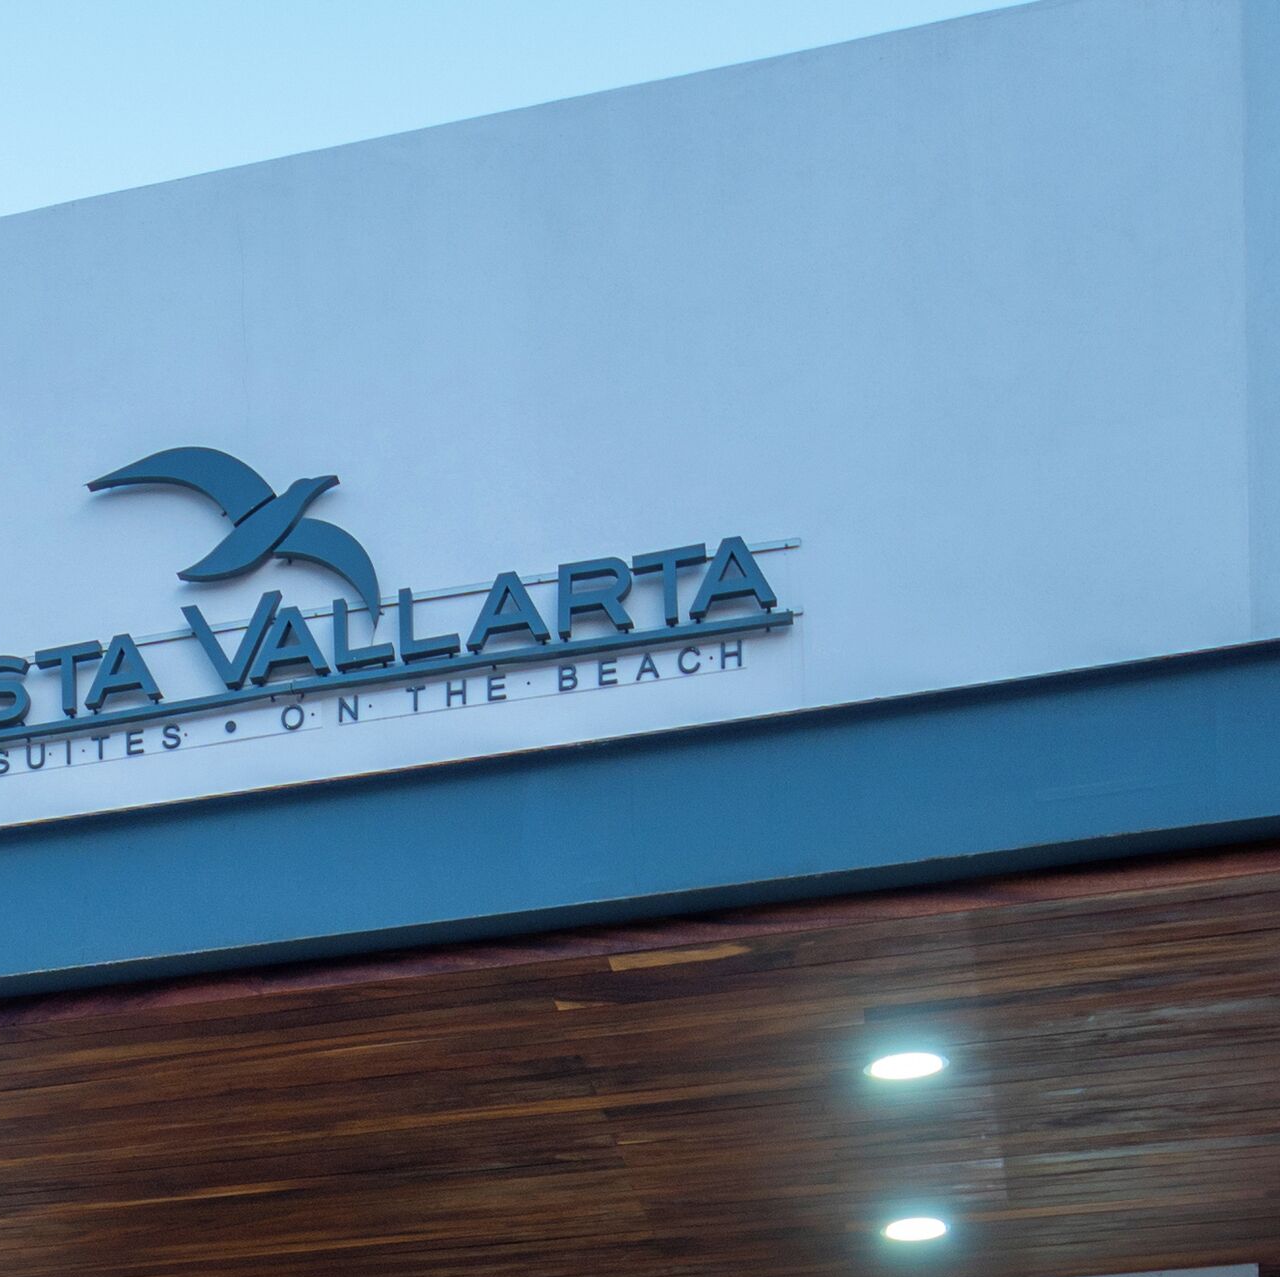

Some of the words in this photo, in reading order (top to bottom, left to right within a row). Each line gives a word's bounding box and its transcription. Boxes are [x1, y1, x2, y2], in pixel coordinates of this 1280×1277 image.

[181, 535, 778, 691] VALLARTA
[280, 695, 360, 731] ON
[405, 675, 508, 713] THE
[558, 639, 743, 692] BEACH
